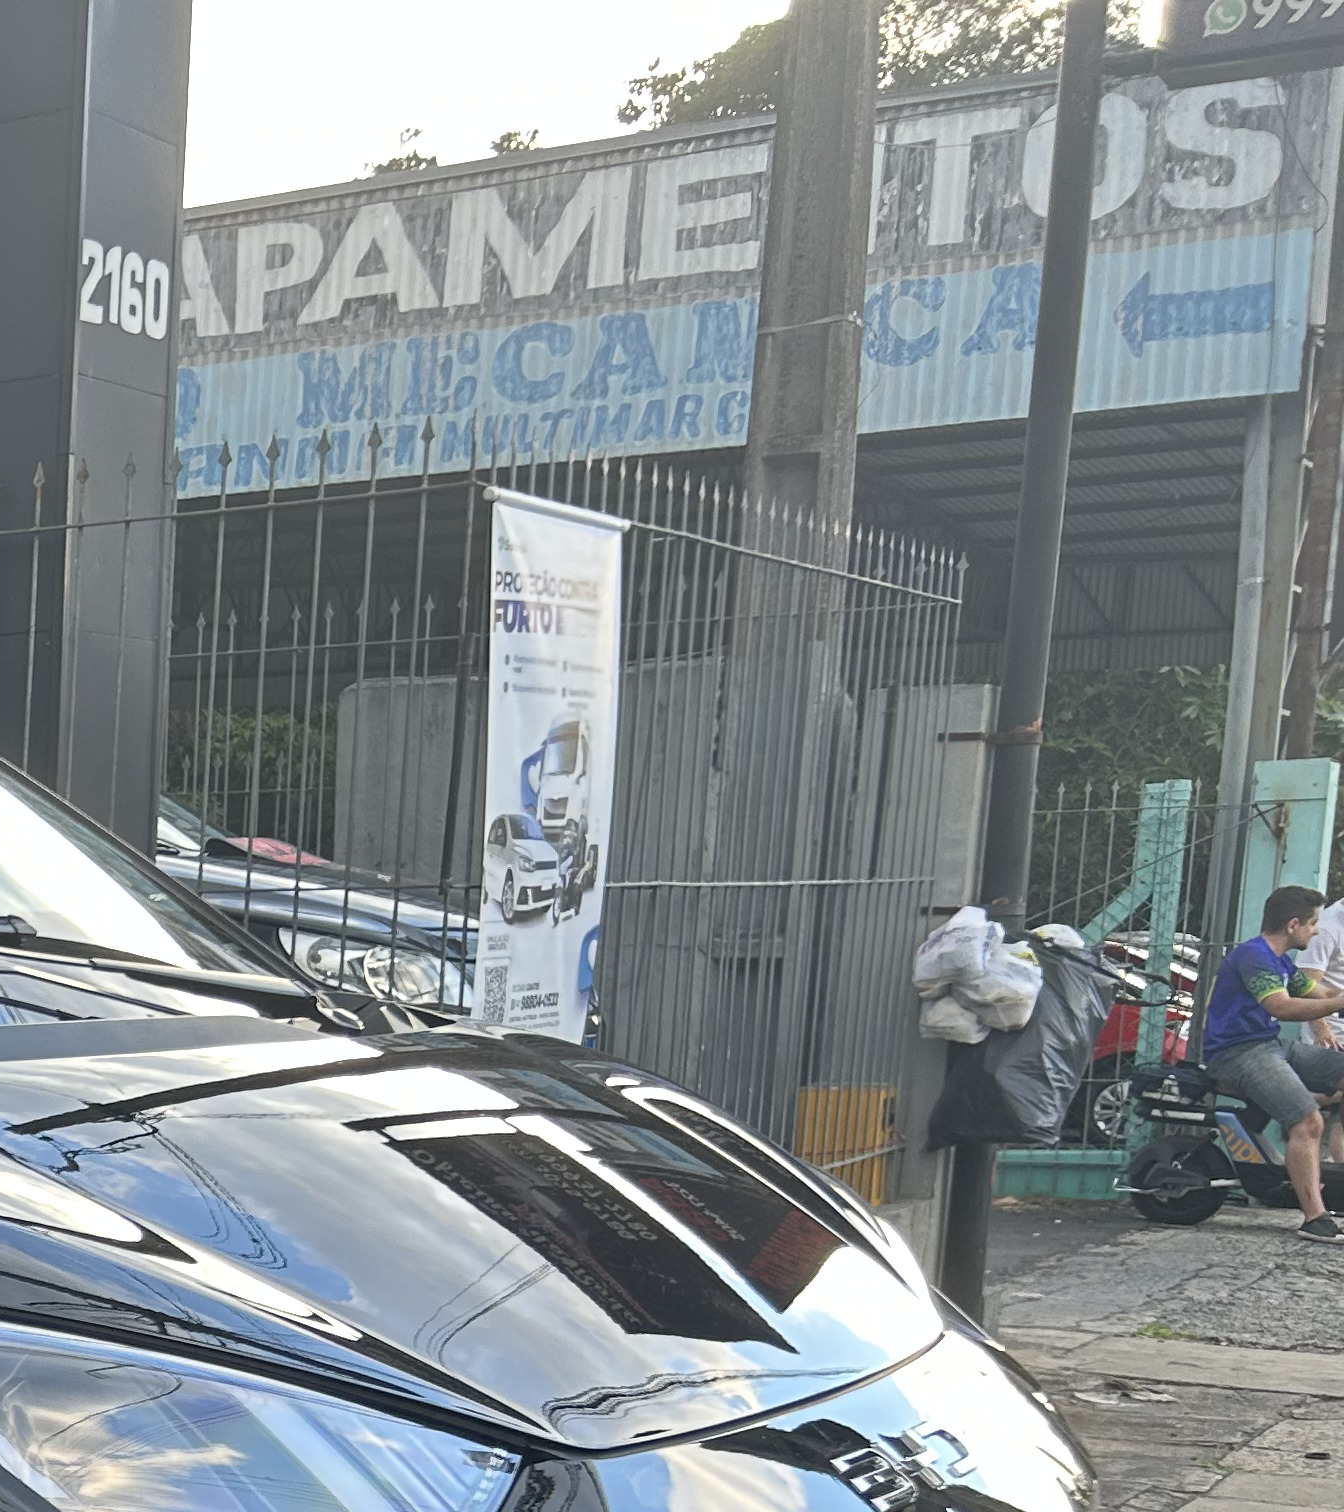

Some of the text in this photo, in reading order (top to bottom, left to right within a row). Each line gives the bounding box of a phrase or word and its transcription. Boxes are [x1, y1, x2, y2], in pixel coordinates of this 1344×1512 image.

[179, 77, 1286, 337] APAMETOS
[79, 238, 169, 340] 2160
[492, 600, 552, 634] FURTO
[494, 570, 557, 598] PROEÇÃO
